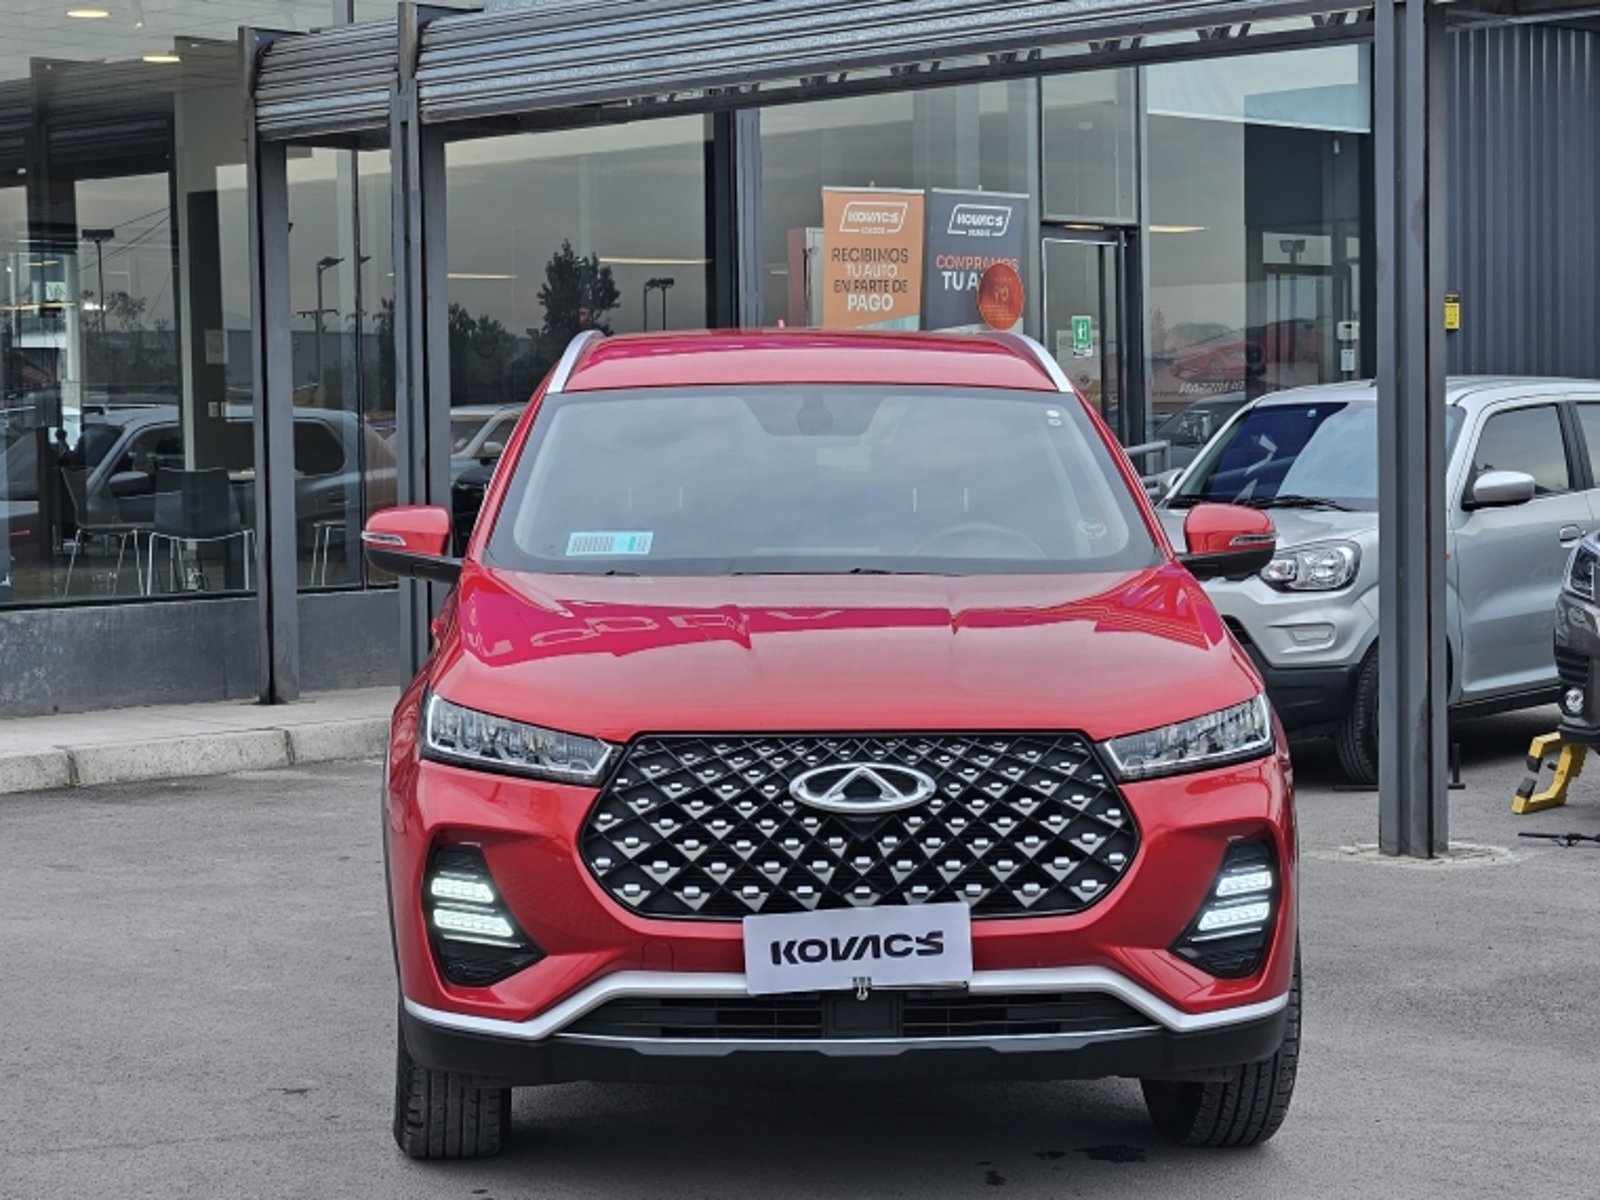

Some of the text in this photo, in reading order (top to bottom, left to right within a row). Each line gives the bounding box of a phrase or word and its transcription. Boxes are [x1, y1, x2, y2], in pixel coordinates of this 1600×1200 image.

[831, 247, 908, 263] RECIBIMOS
[845, 263, 897, 278] TU AUTO
[833, 279, 908, 293] EN PARTE DE
[941, 271, 965, 291] TU
[847, 293, 893, 312] PAGO
[770, 930, 944, 966] KOVACS
